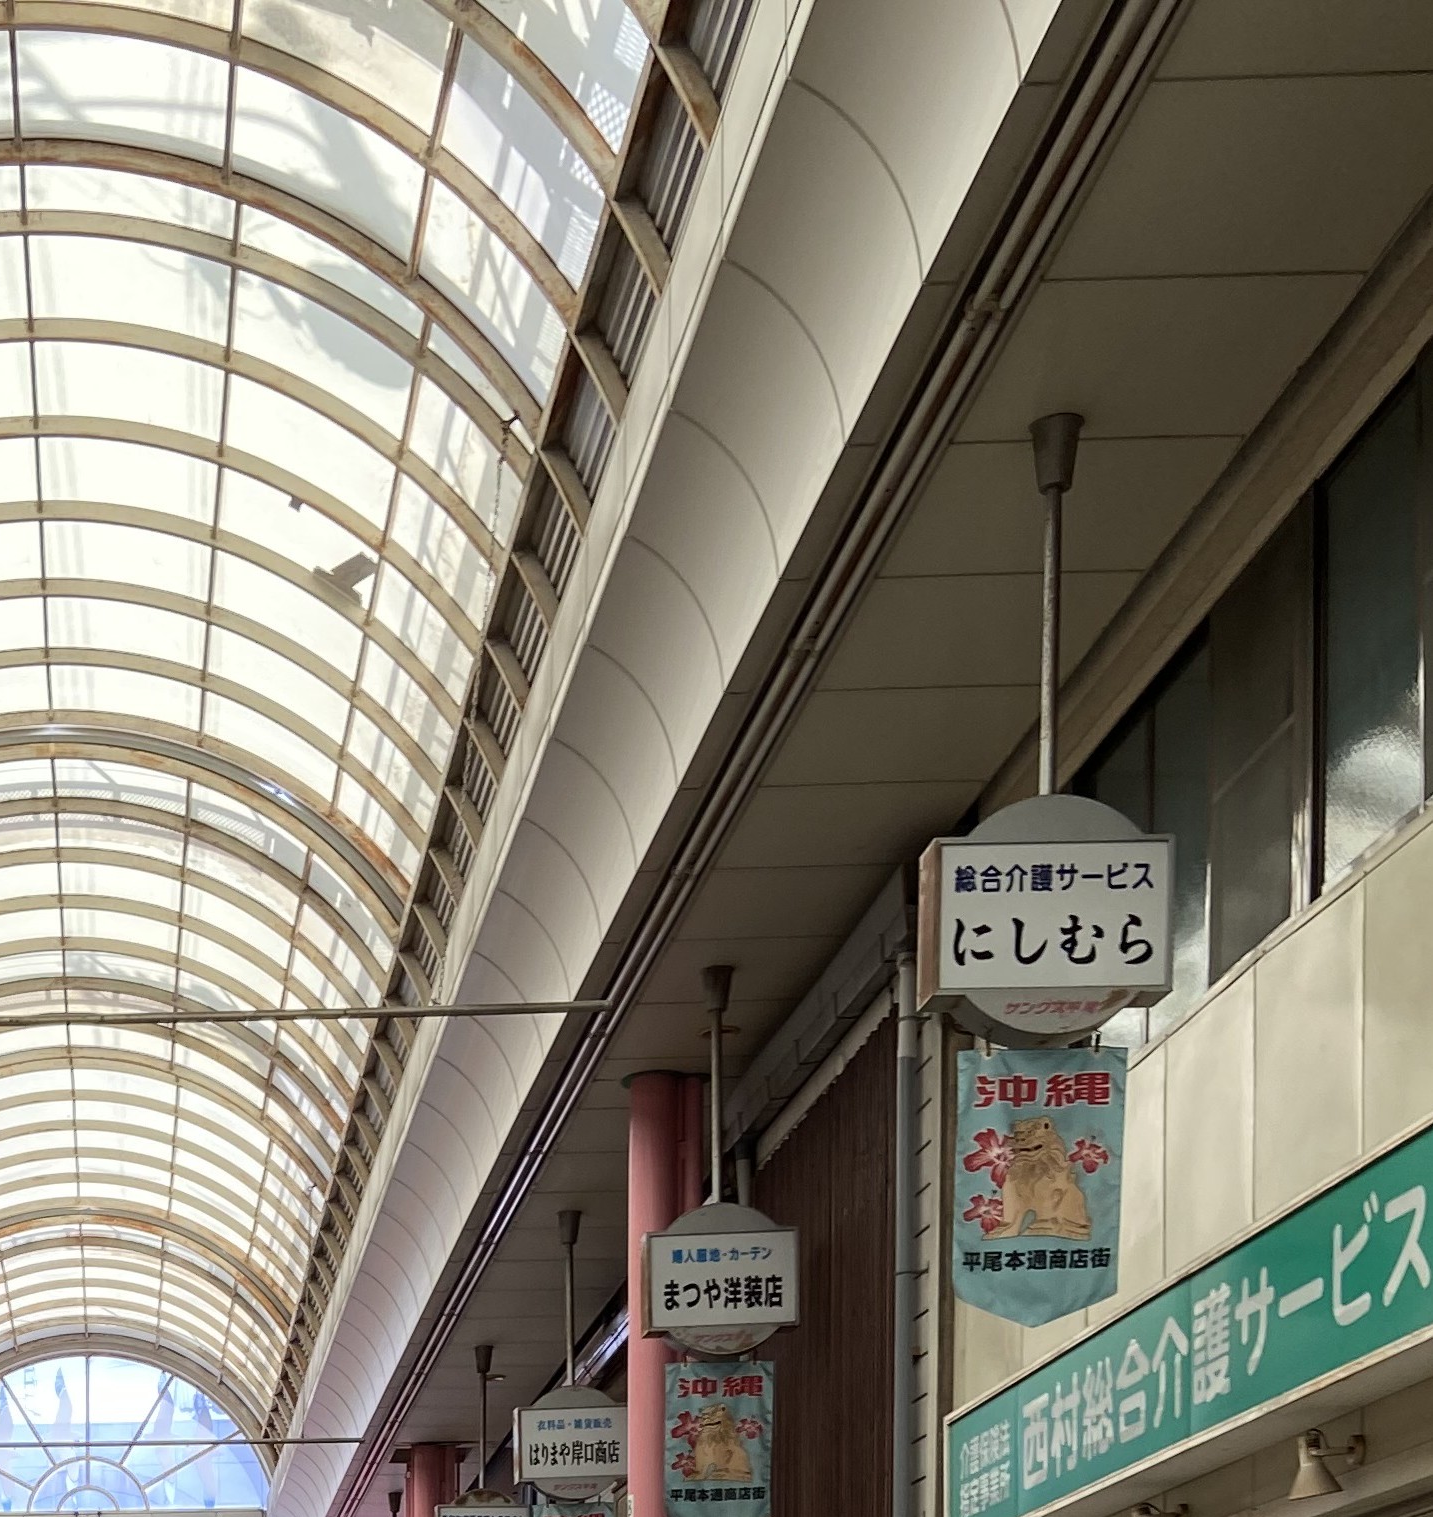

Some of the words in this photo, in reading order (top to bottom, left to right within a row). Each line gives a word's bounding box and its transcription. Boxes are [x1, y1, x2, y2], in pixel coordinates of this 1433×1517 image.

[954, 862, 1154, 893] 総合介護サービス
[953, 914, 1154, 967] にしむら
[973, 1071, 1112, 1109] 沖縄
[963, 1247, 1111, 1273] 平尾本通商店街
[663, 1274, 783, 1311] まつや洋装店
[1022, 1184, 1432, 1490] 西村総合介護サービス
[677, 1375, 763, 1398] 沖縄
[529, 1440, 620, 1467] はりまや岸口商店
[670, 1487, 765, 1502] 平尾本通商店街
